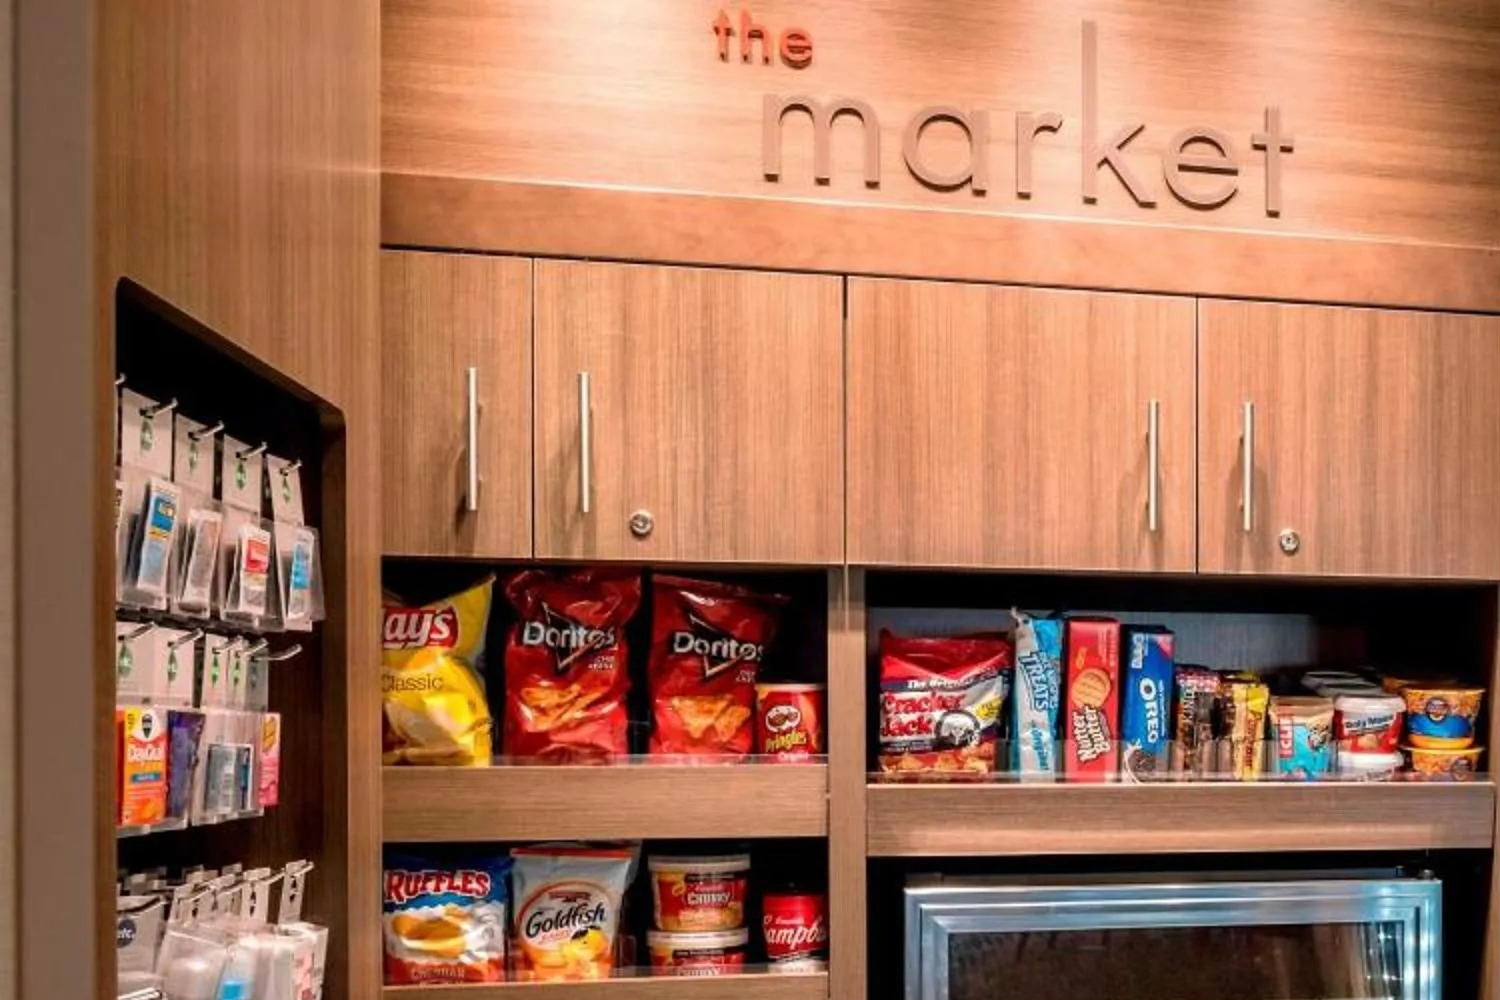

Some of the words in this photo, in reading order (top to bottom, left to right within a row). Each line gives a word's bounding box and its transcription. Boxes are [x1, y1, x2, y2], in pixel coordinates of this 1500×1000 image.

[711, 8, 814, 67] the
[760, 21, 1295, 218] market
[384, 609, 453, 647] ay's
[522, 620, 614, 648] Doritos
[382, 674, 444, 692] Classic
[1019, 652, 1049, 711] TREATS
[883, 690, 966, 714] Cracker
[1139, 678, 1158, 744] OREO
[765, 728, 807, 752] Pringles
[881, 715, 932, 738] Jack
[1073, 711, 1097, 763] Nutter
[1085, 706, 1112, 755] Butter
[384, 869, 491, 904] RUFFLES
[525, 902, 606, 939] Goldfish
